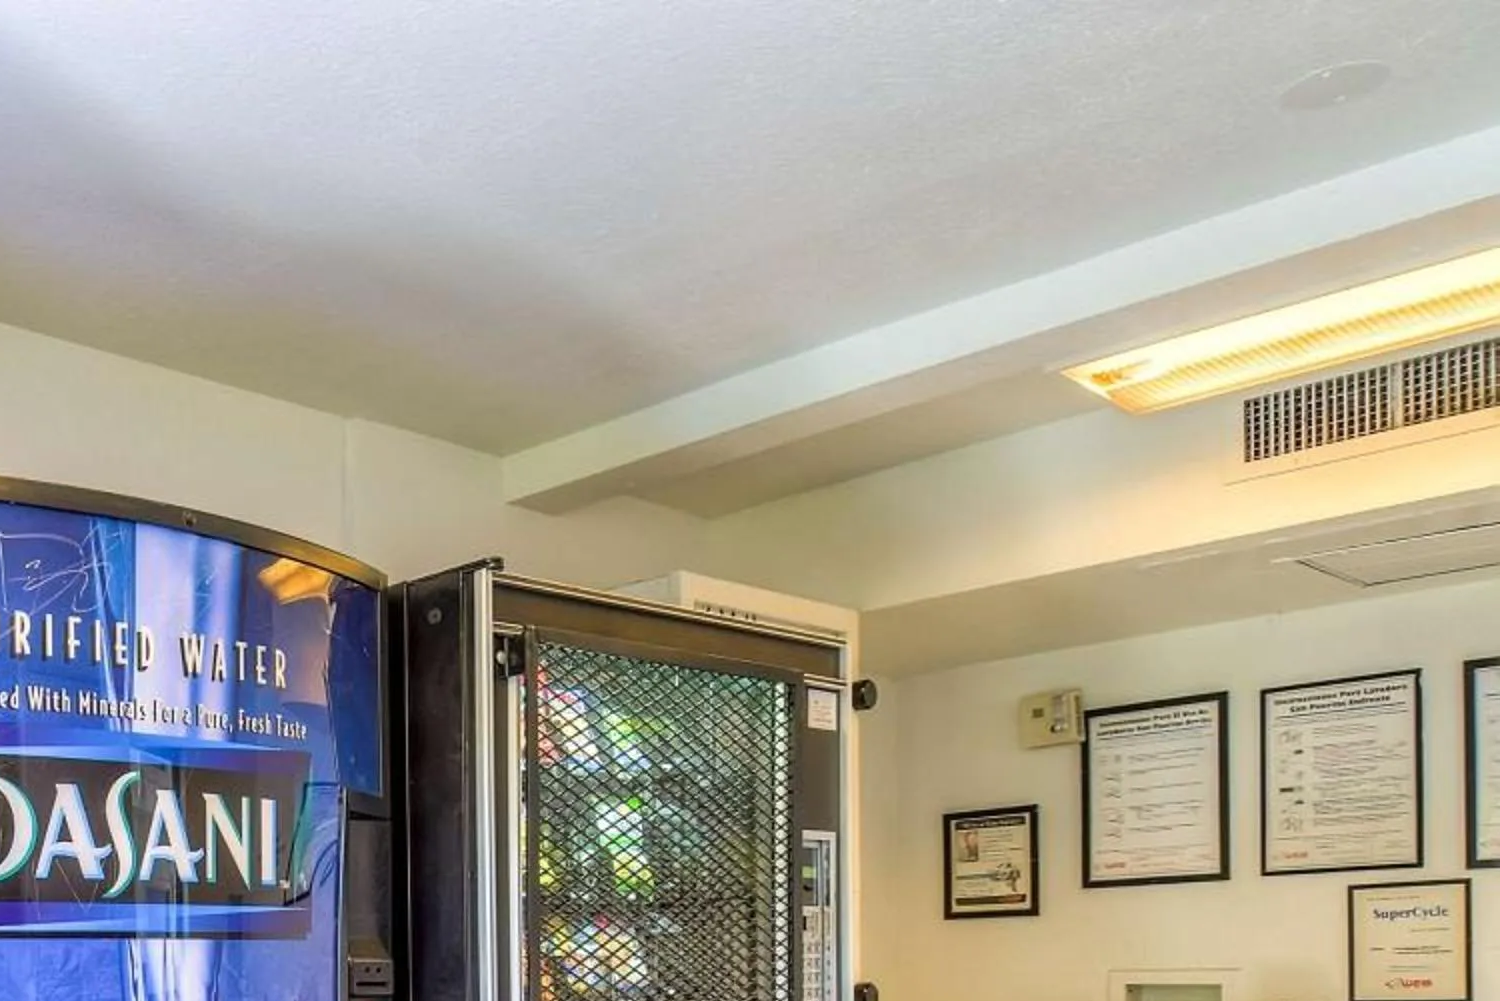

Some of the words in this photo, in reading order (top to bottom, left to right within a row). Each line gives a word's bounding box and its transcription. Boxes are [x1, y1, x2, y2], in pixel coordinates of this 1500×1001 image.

[179, 632, 287, 690] WATER
[27, 684, 71, 714] With
[78, 691, 146, 721] Minerals
[153, 700, 176, 724] For
[238, 708, 272, 736] Fresh
[276, 713, 308, 740] Taste
